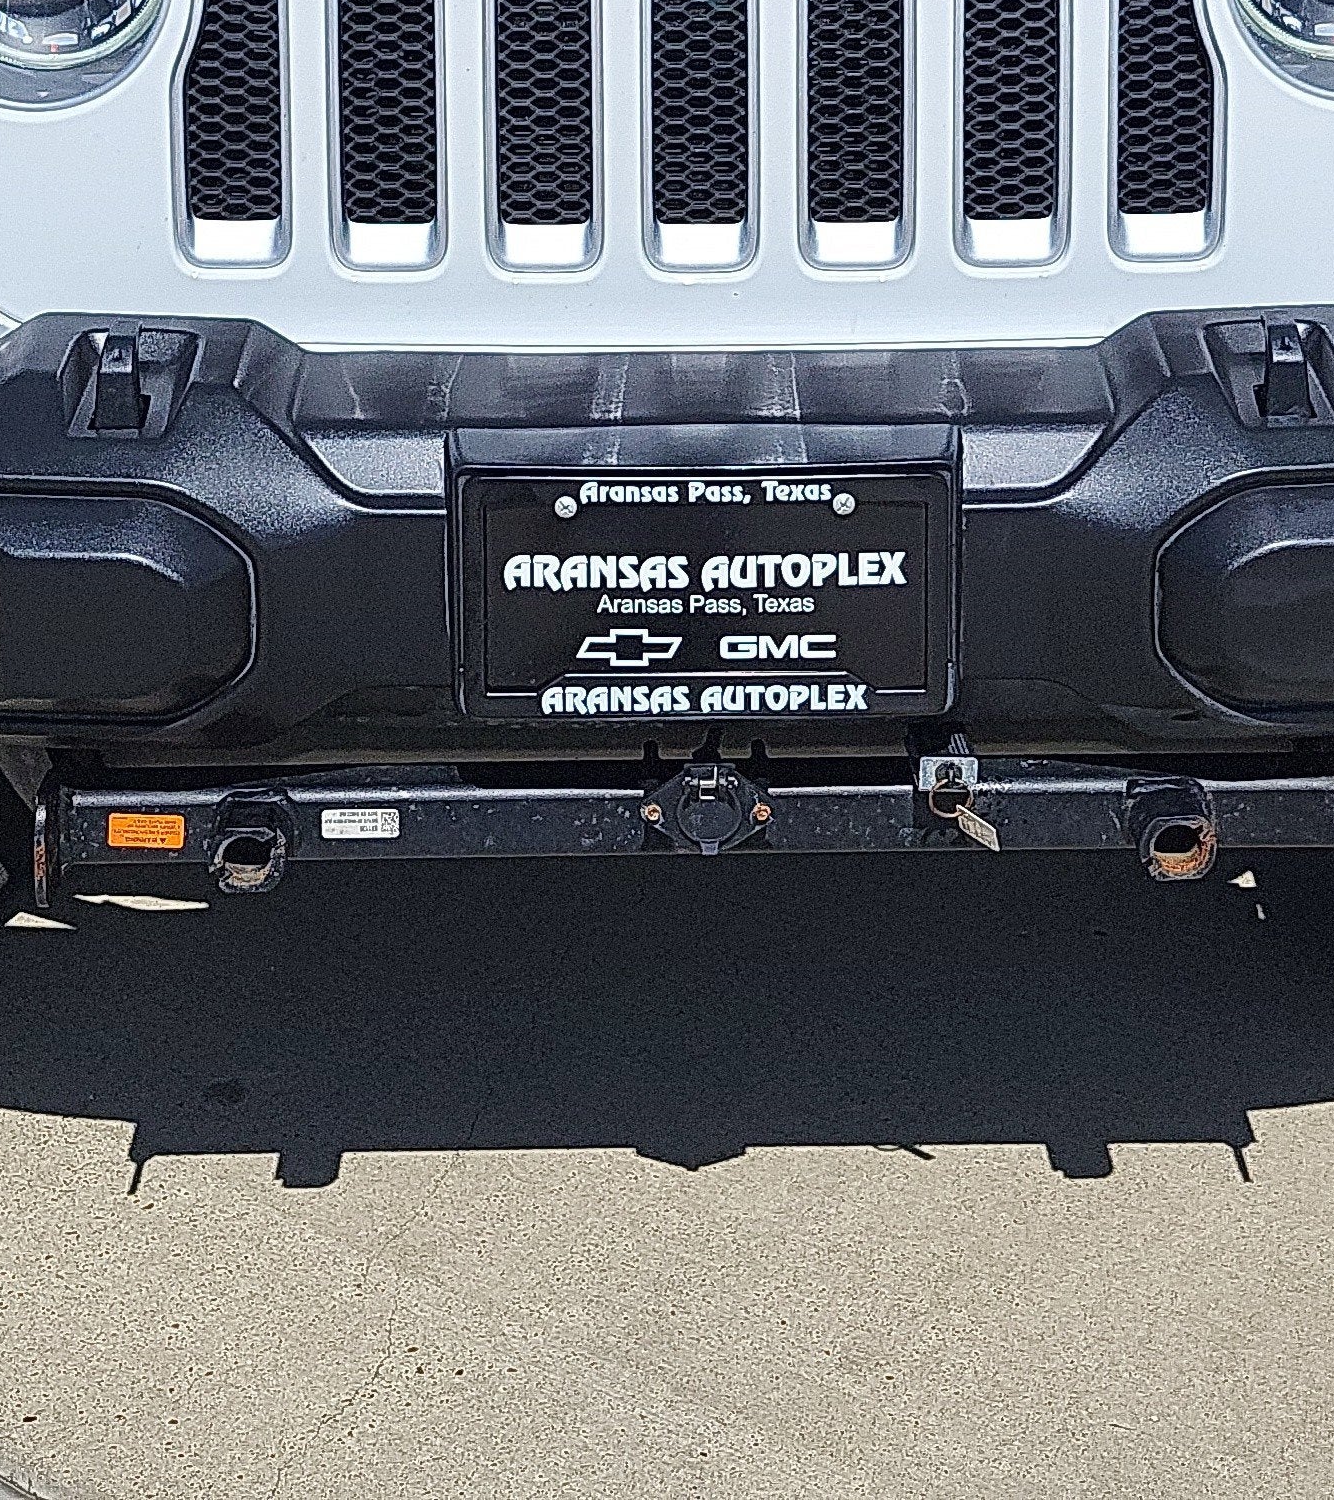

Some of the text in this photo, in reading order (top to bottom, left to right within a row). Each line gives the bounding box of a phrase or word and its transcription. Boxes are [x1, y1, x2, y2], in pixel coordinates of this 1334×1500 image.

[579, 479, 832, 505] Aransas Pass, Texas
[504, 552, 908, 592] ARANSAS AUTOPLEX
[597, 594, 815, 615] Aransas Pass, Texas
[719, 634, 837, 660] GMC
[541, 684, 868, 715] ARANSAS AUTOPLEX
